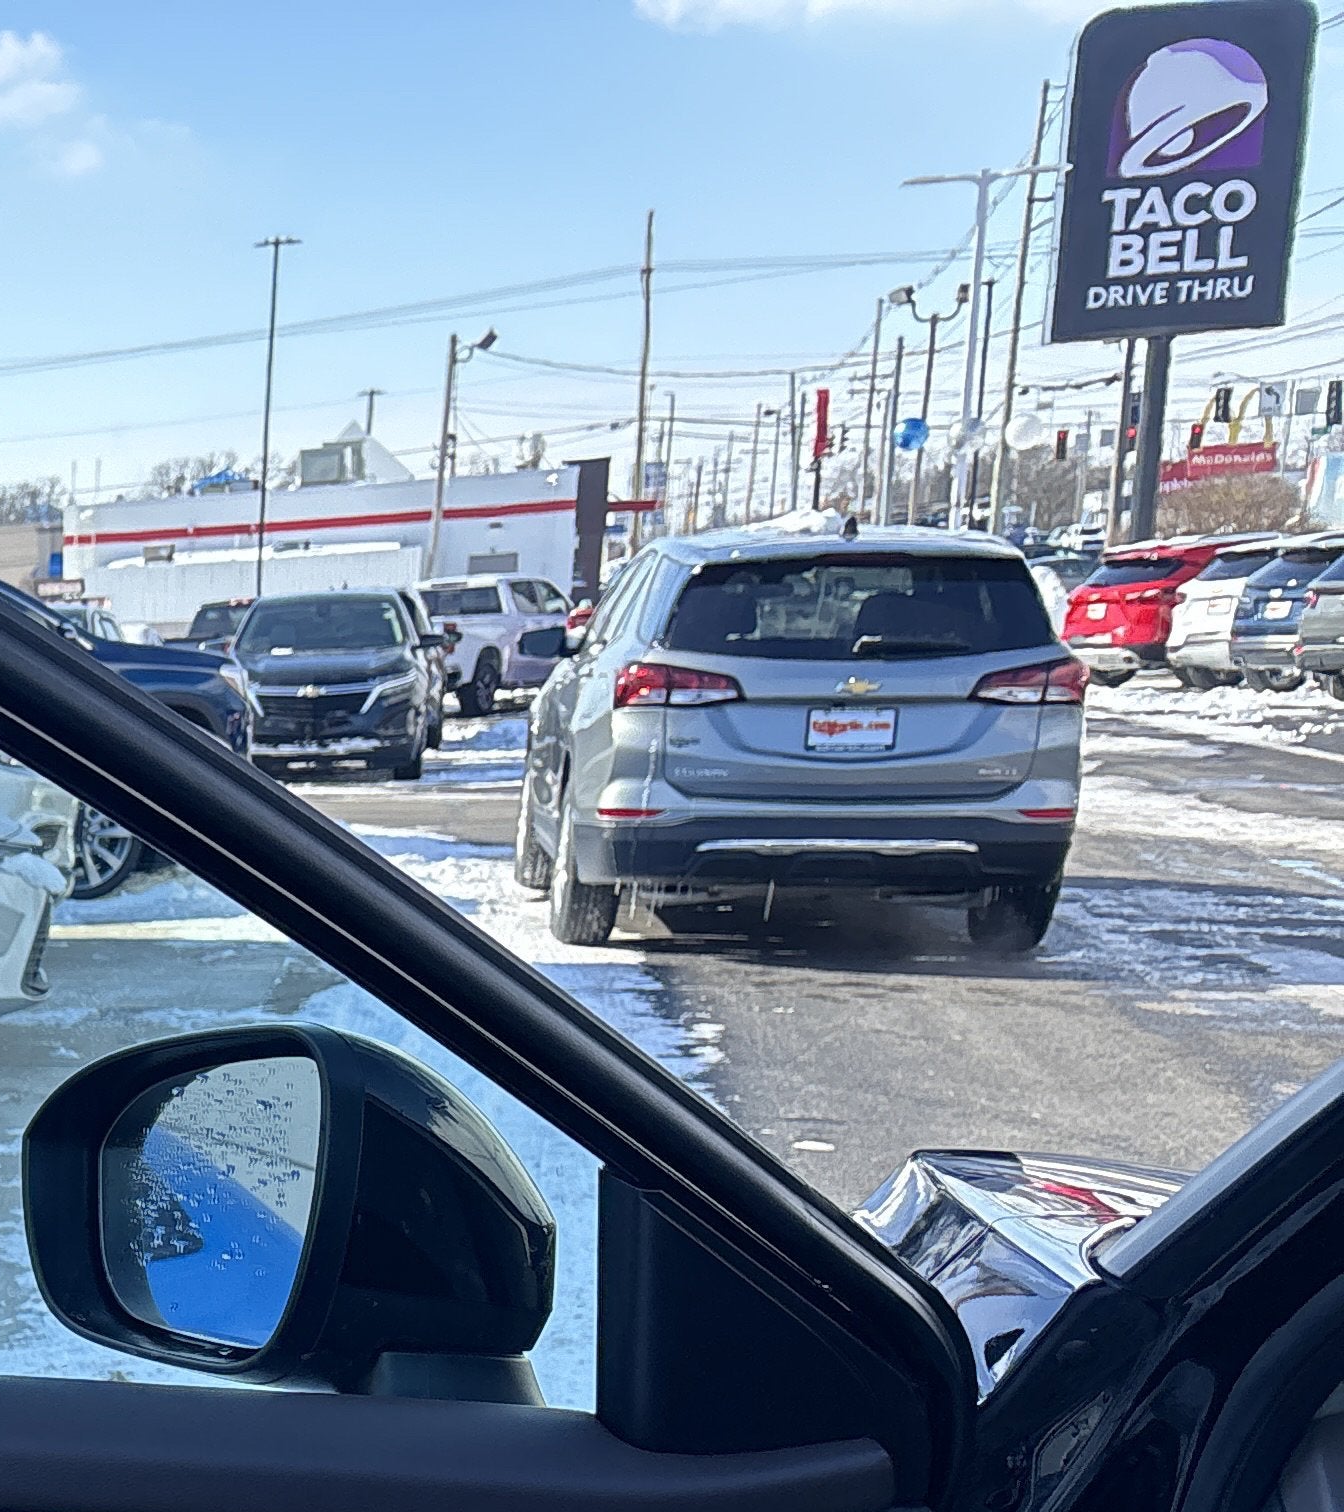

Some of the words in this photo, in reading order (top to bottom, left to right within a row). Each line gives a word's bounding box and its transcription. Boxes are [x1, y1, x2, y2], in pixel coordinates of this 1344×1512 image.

[1102, 179, 1257, 232] TACO
[1107, 226, 1249, 279] BELL
[1085, 281, 1170, 309] DRIVE
[1176, 275, 1255, 304] THRU
